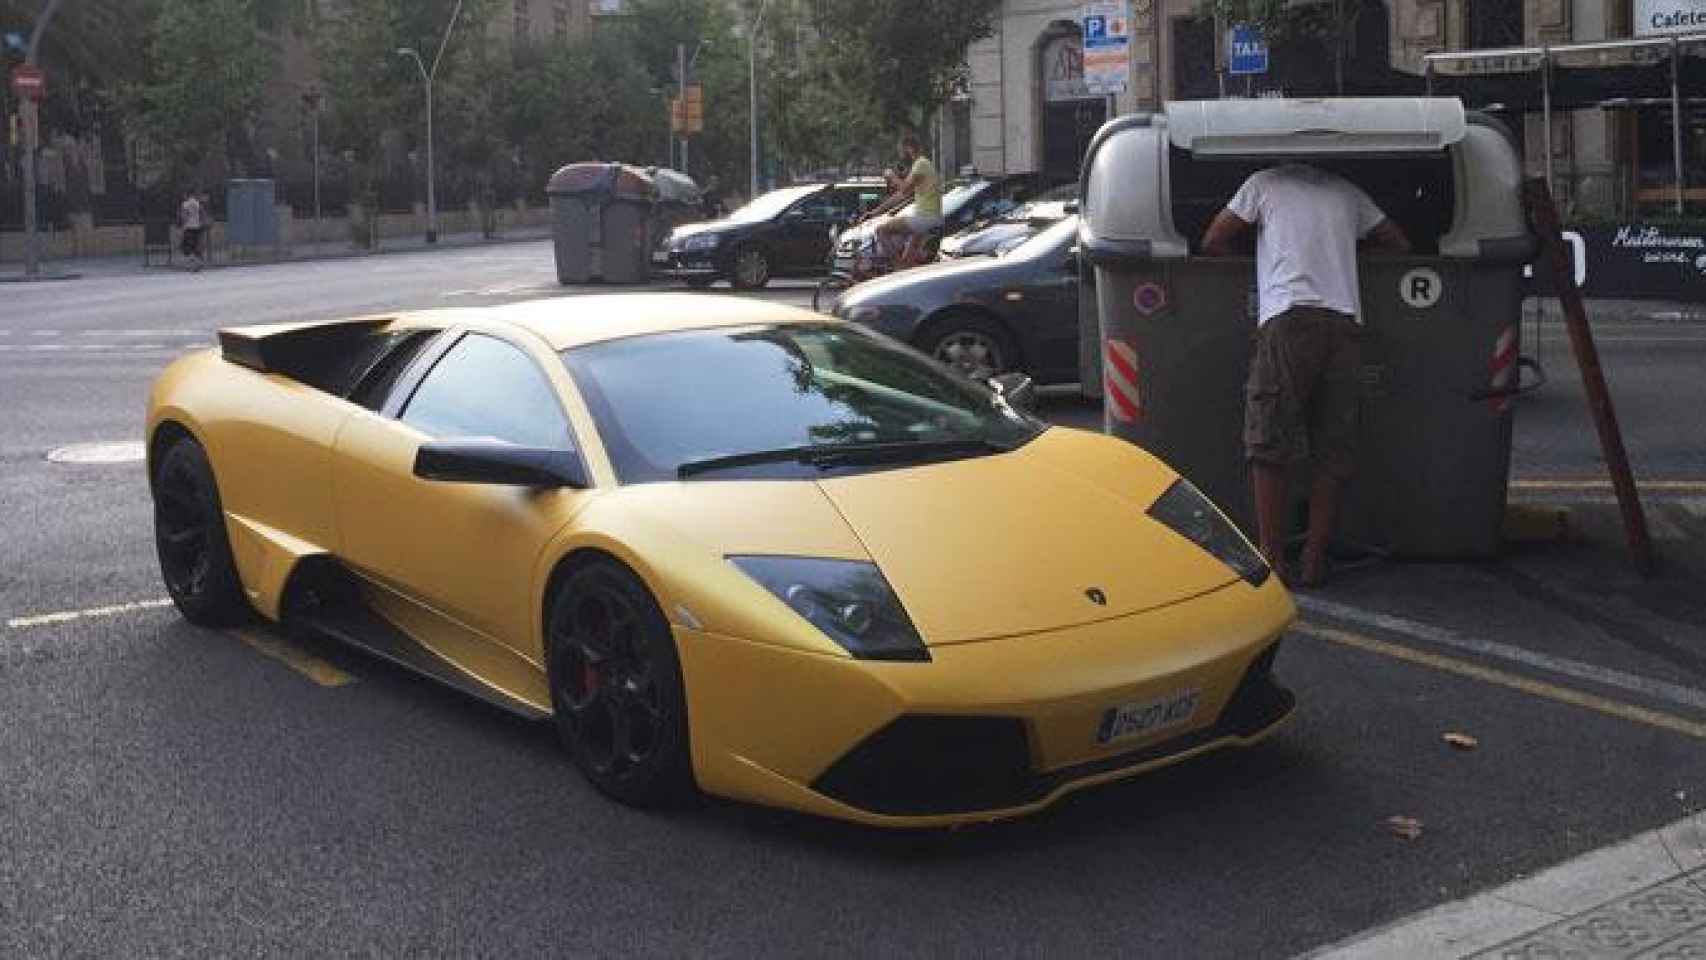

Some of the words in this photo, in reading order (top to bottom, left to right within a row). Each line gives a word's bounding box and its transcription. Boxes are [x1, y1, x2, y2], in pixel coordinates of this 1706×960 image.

[1086, 19, 1098, 38] P
[1233, 41, 1264, 57] TAX
[1411, 276, 1430, 300] R
